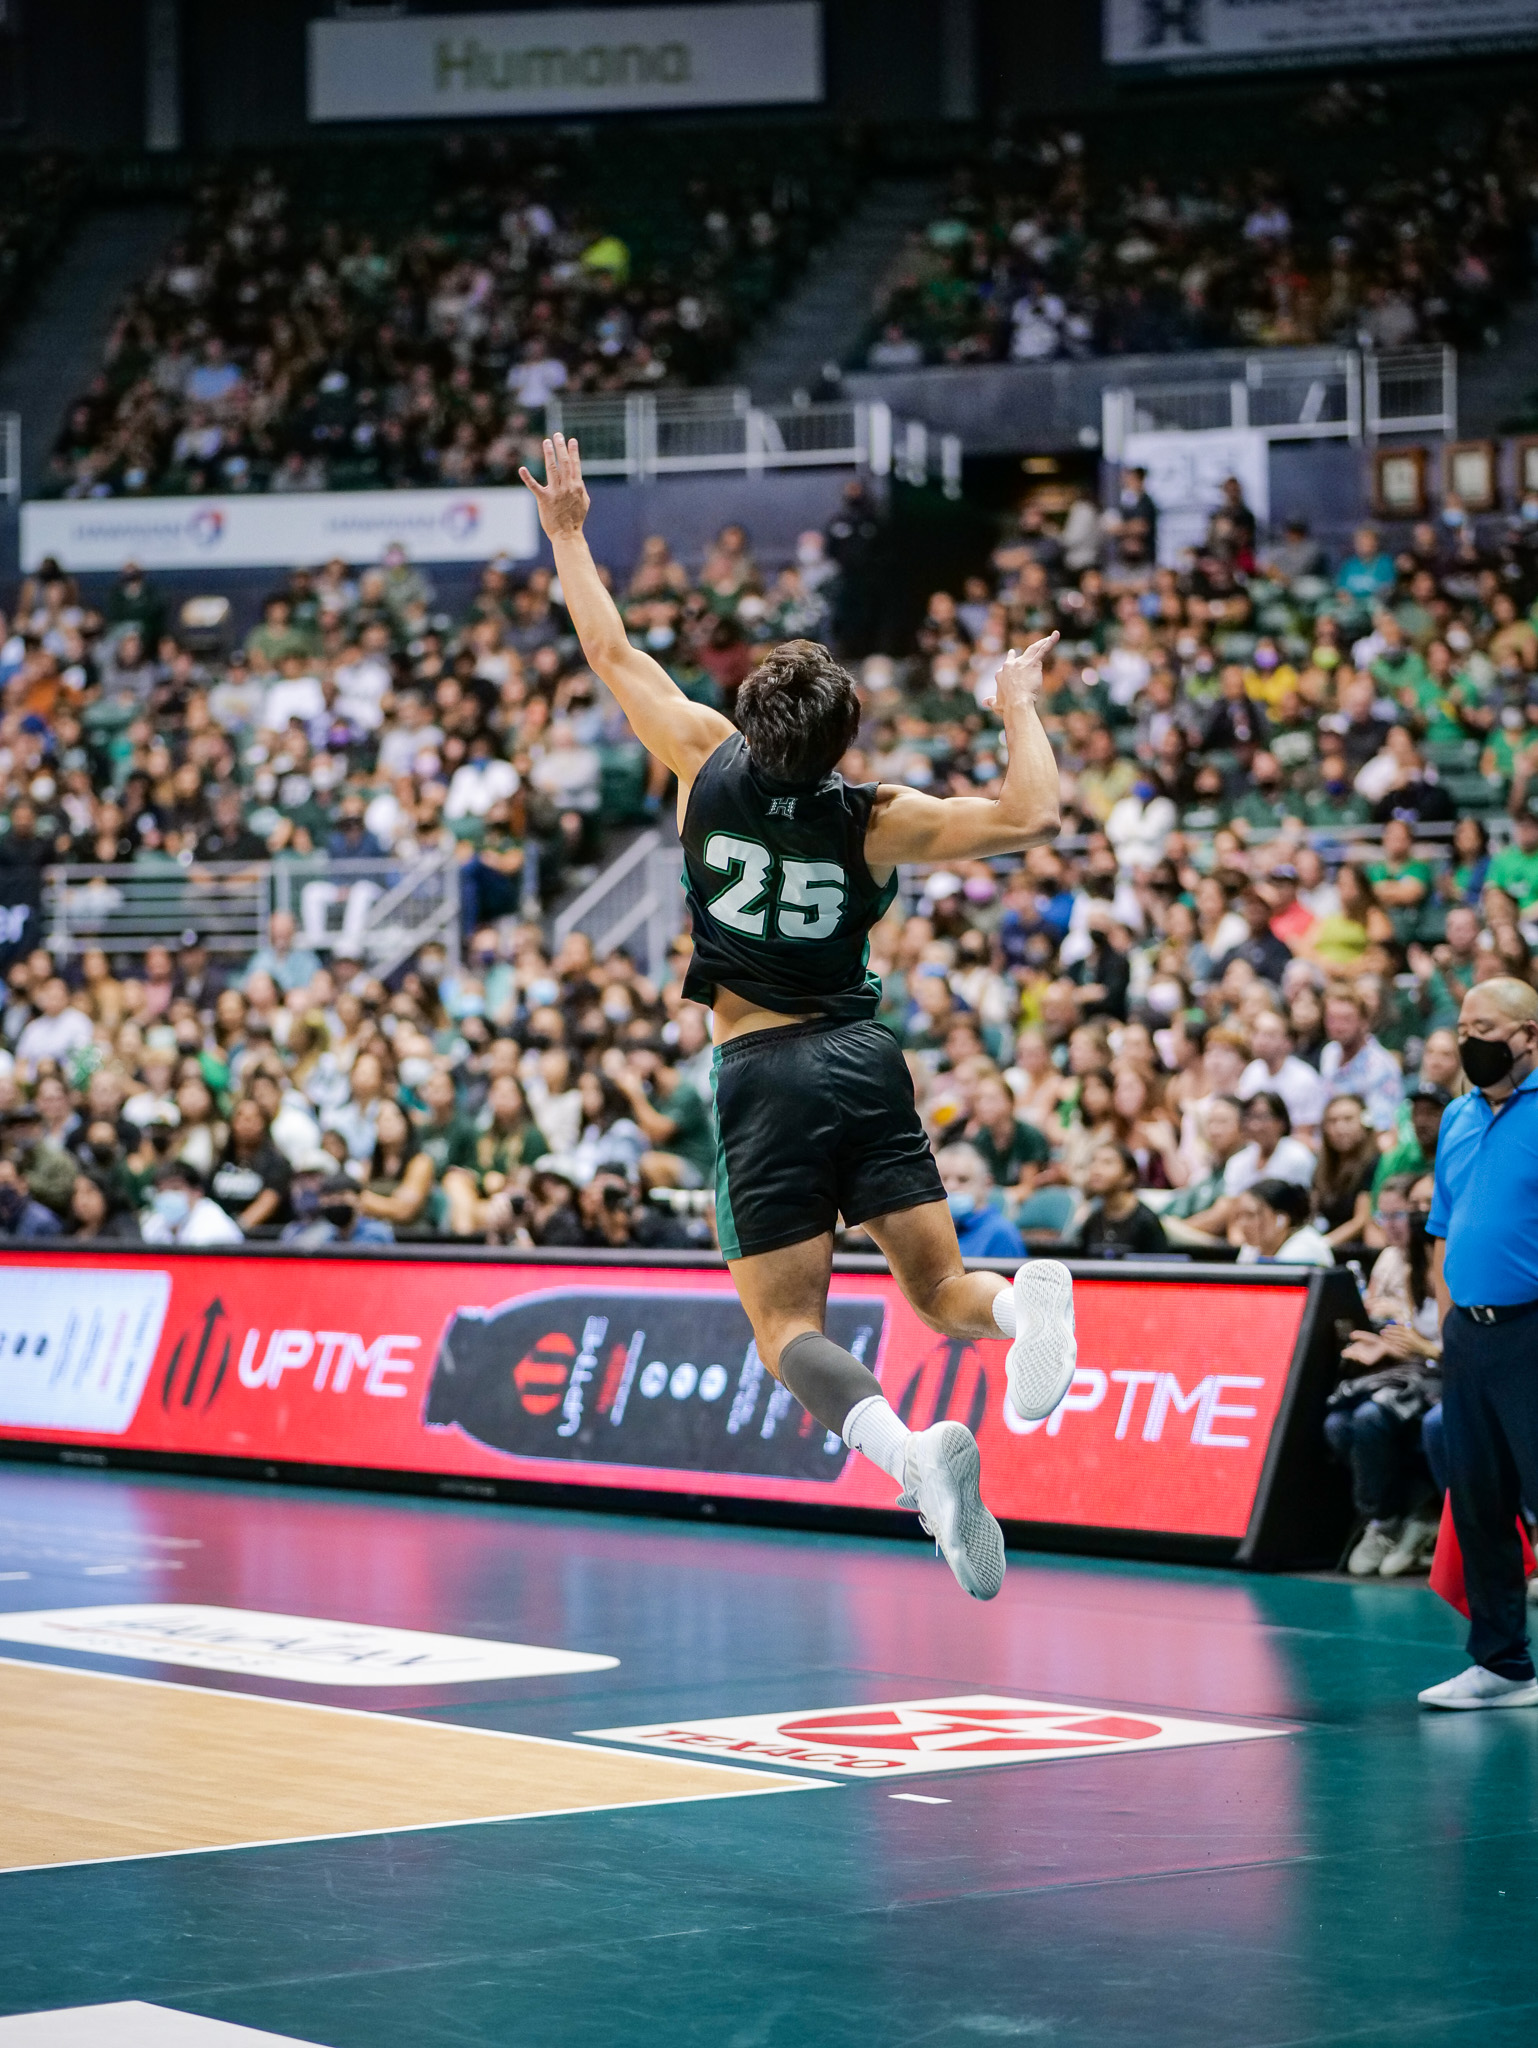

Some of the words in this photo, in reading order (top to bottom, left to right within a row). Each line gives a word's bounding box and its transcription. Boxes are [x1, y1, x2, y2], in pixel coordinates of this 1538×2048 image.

[433, 37, 692, 92] Humana
[704, 830, 849, 942] 25
[638, 1730, 907, 1769] TEXACO
